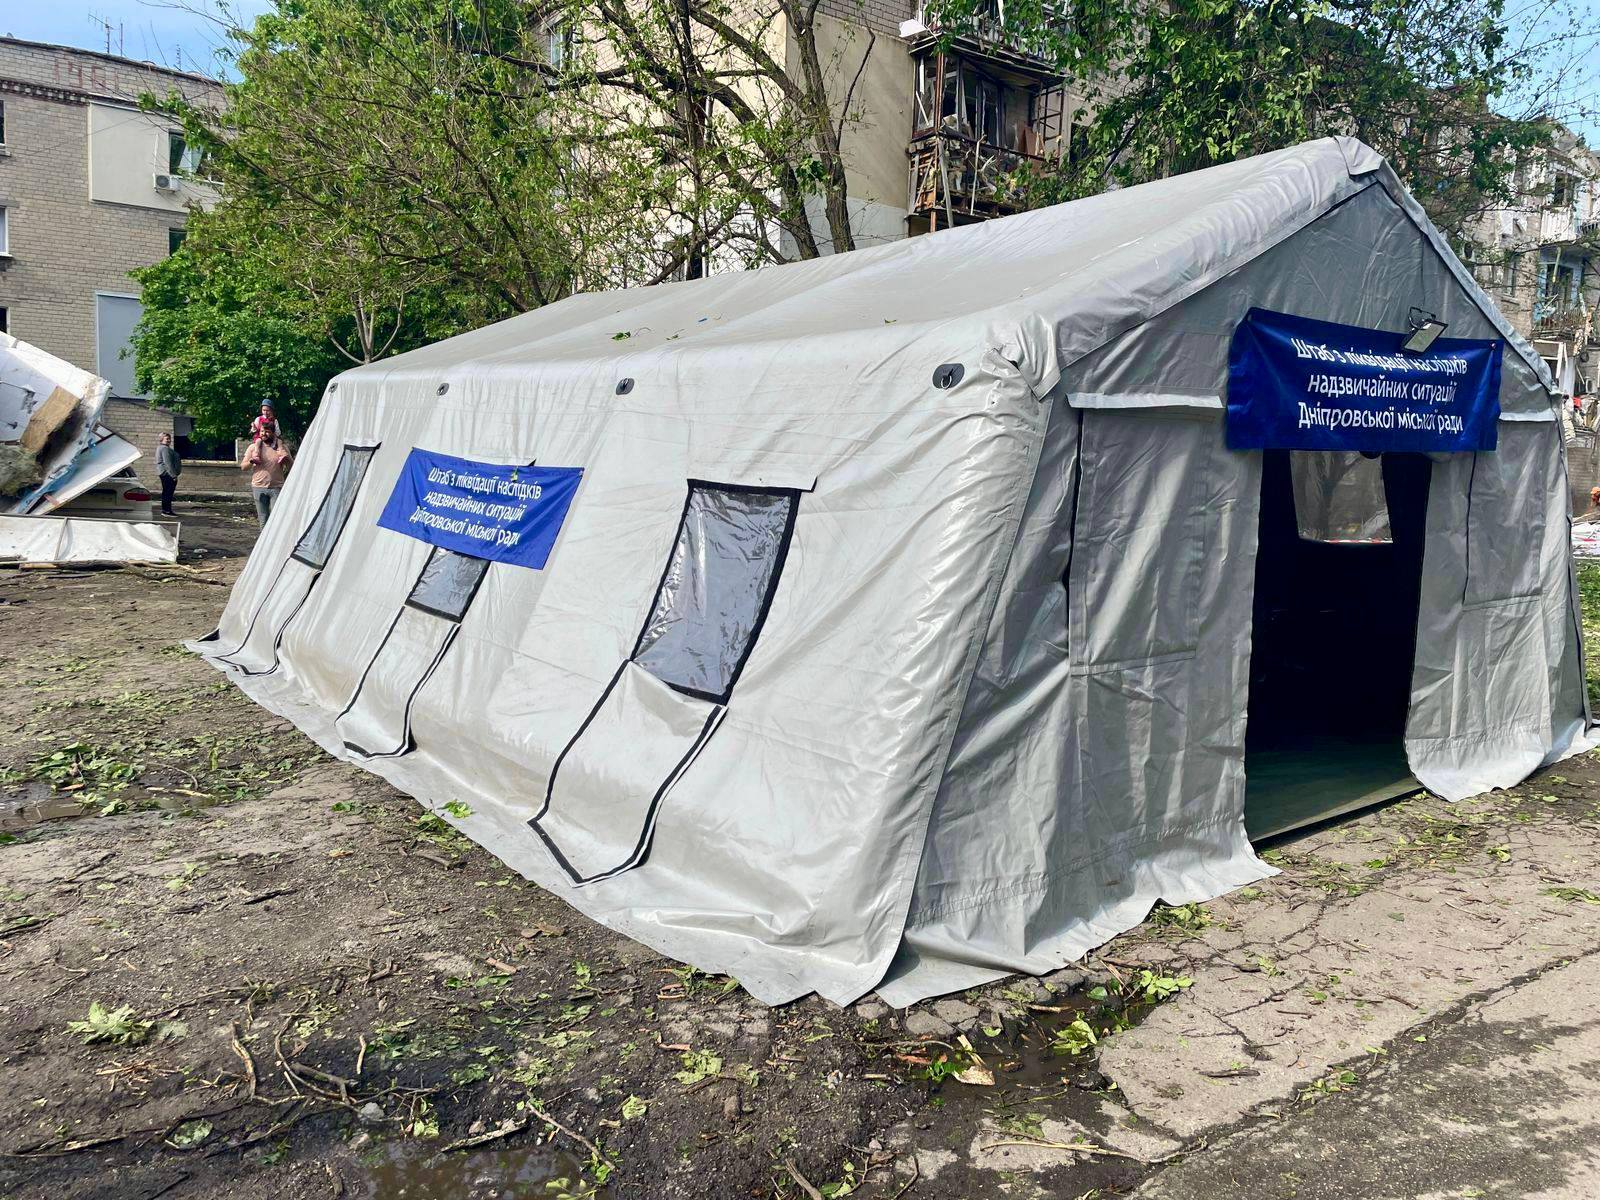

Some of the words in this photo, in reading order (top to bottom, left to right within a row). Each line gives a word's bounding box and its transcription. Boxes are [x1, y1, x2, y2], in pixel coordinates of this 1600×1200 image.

[1291, 337, 1335, 362] Штаб
[1335, 351, 1346, 363] з
[1345, 347, 1412, 372] ліквідації
[1411, 355, 1467, 376] наслідків
[1308, 374, 1409, 400] надзвичайних
[1412, 381, 1457, 405] ситуацій
[1298, 401, 1395, 430] Дніпровської
[1398, 407, 1438, 430] міської
[1438, 413, 1463, 436] ради
[428, 467, 452, 483] Штаб
[456, 472, 498, 493] ліквідації
[497, 480, 542, 500] наслідків
[423, 491, 486, 514] надзвичайних
[486, 503, 527, 521] ситуацій
[467, 521, 500, 541] міської
